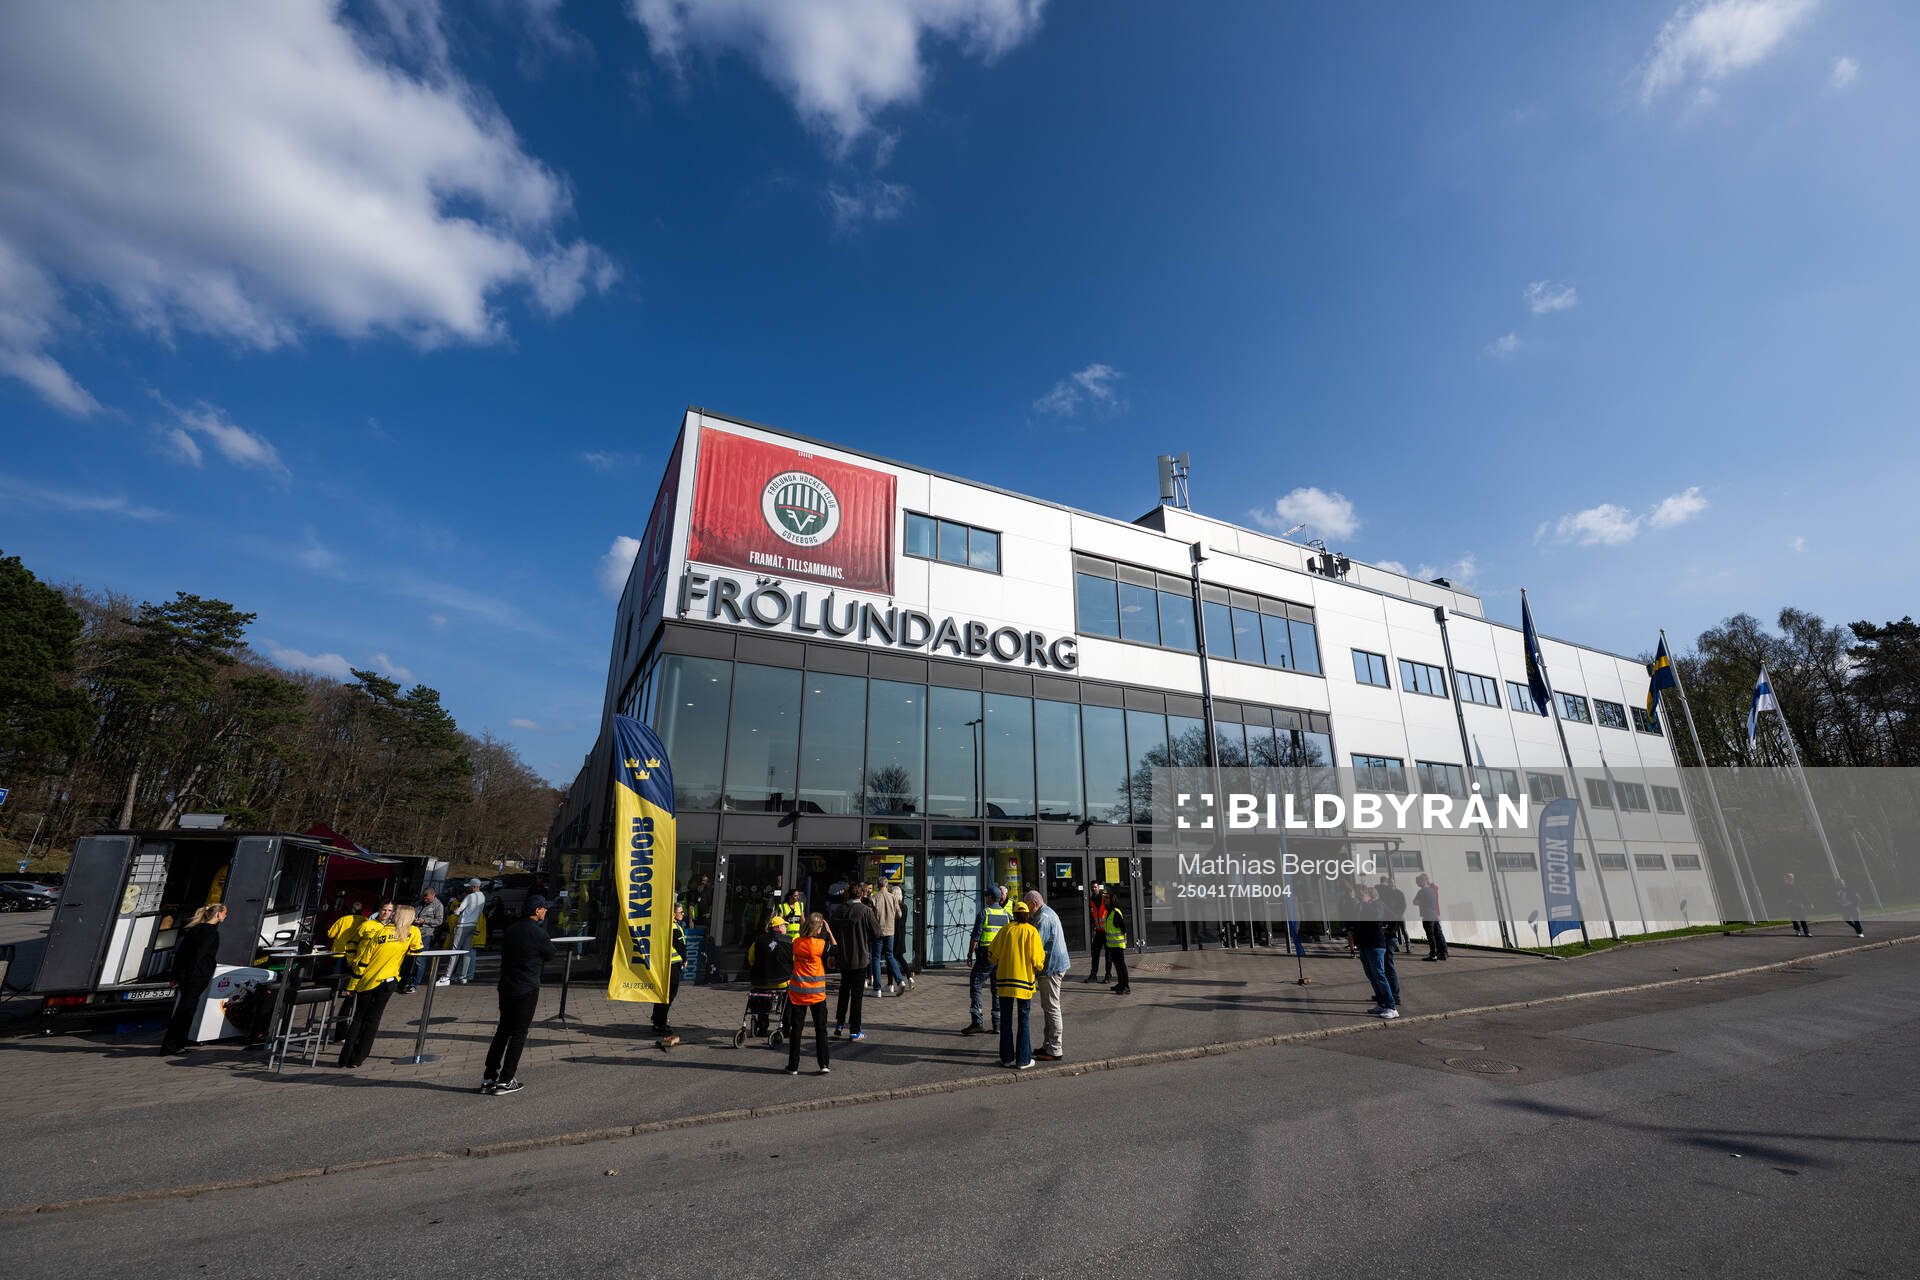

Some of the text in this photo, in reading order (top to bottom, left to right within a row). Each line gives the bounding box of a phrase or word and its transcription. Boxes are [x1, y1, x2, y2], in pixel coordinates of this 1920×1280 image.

[800, 475, 825, 492] HOCKEY
[823, 492, 836, 509] CLUB
[782, 530, 818, 544] GÖTEBORG
[787, 558, 845, 580] TILLSAMMANS.
[681, 572, 1079, 670] FRÖLUNDABORG
[1545, 837, 1571, 895] NOCCO
